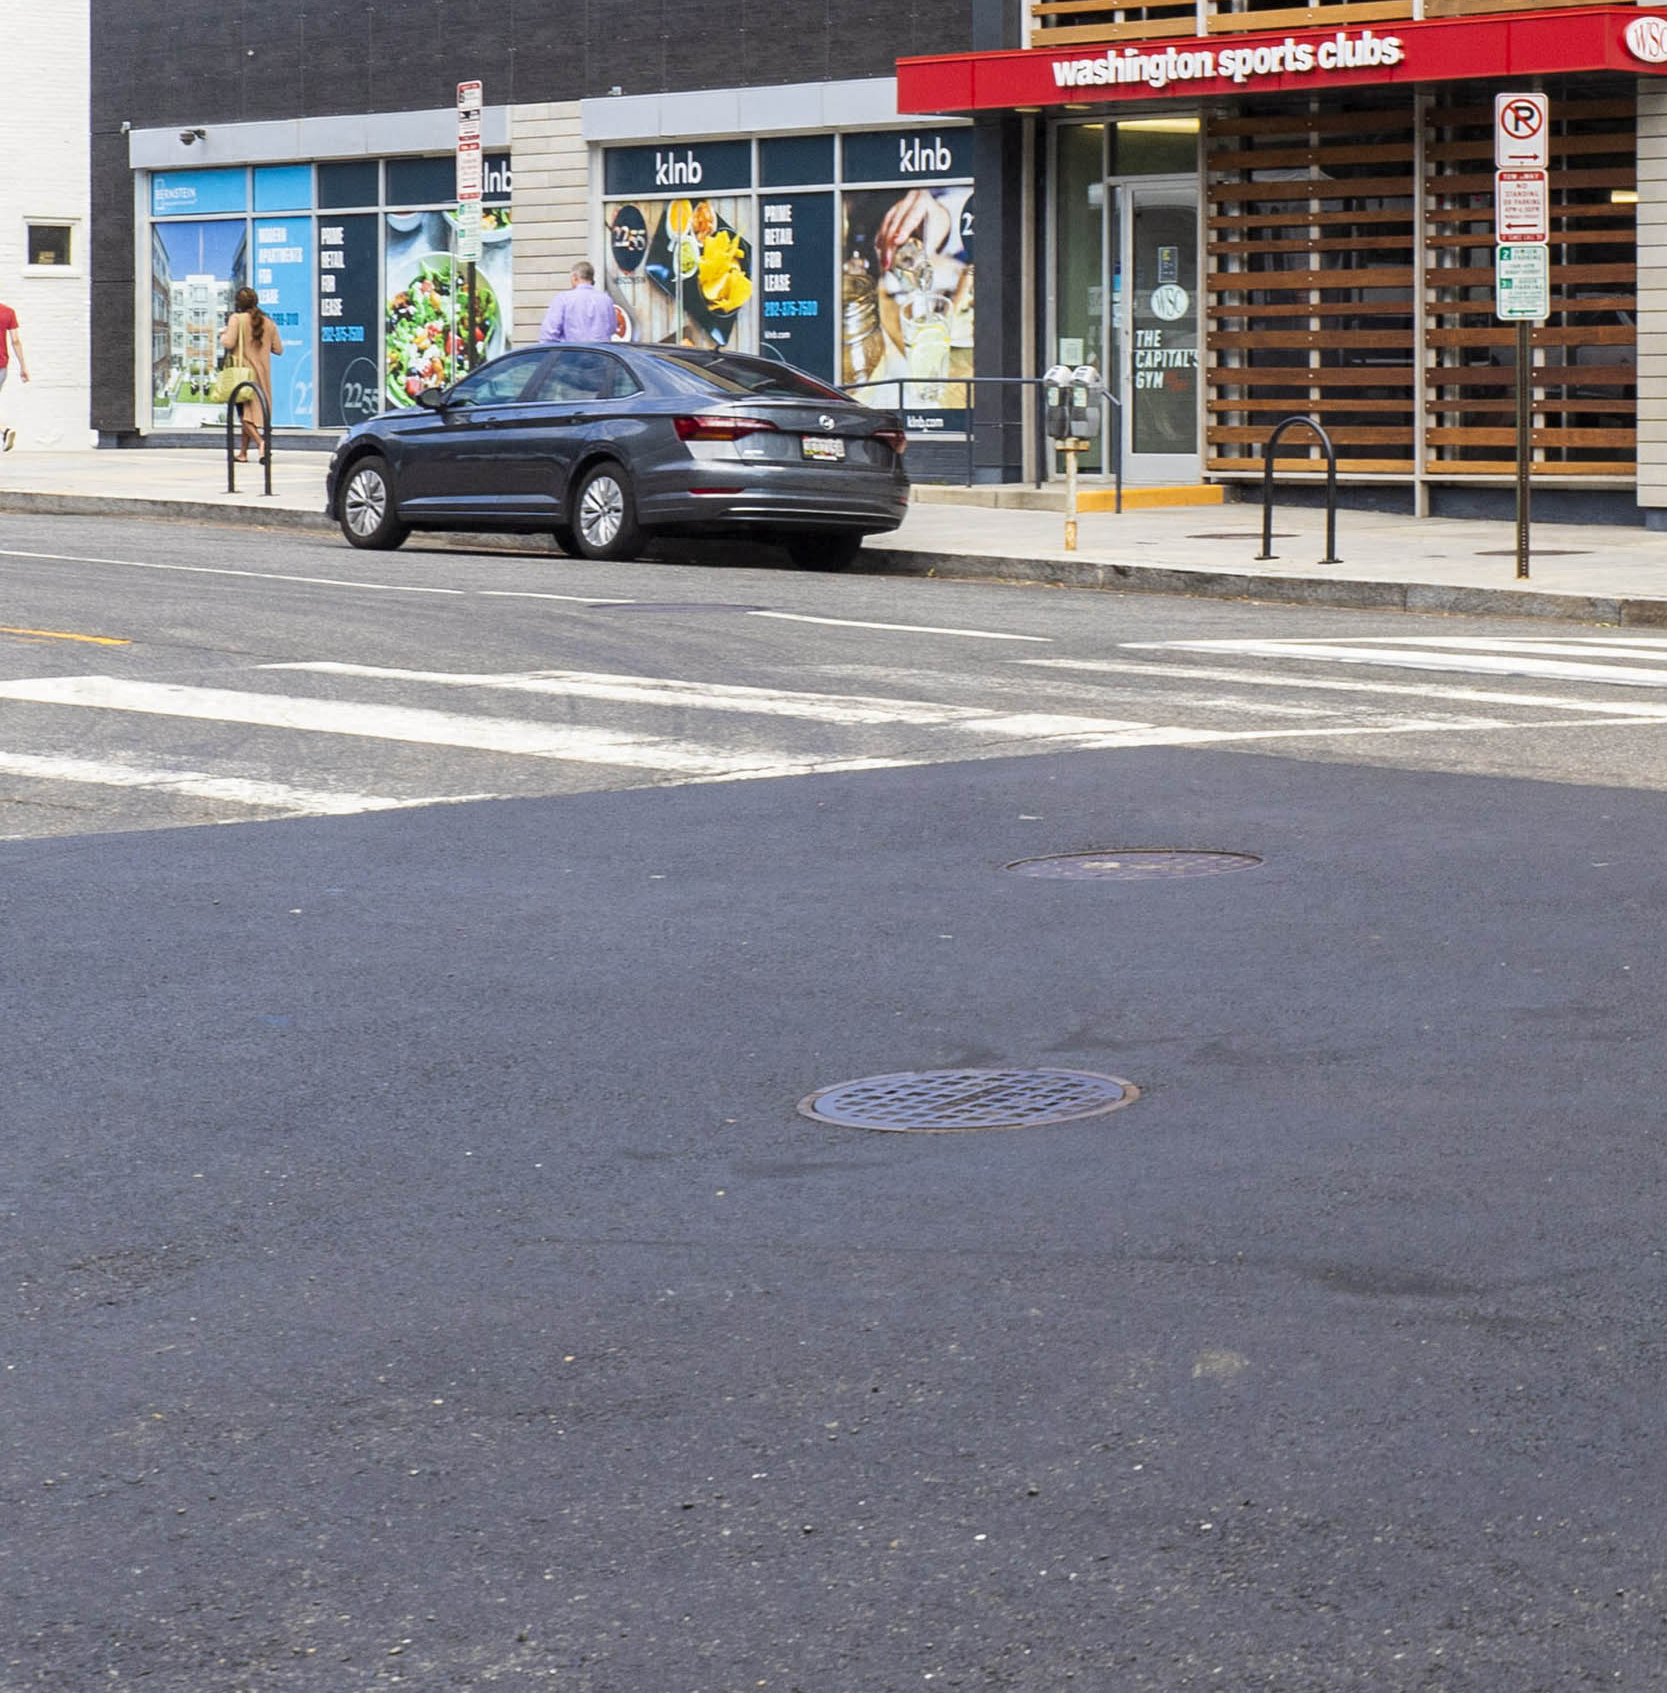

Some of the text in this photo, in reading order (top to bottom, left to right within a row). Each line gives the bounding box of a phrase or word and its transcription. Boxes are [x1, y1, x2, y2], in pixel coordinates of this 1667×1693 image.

[1052, 31, 1404, 88] washington sports clubs
[900, 137, 951, 172] klnb
[480, 161, 512, 194] lnb
[656, 151, 703, 186] klnb
[764, 204, 792, 223] PRIME
[764, 228, 794, 245] RETAIL
[764, 251, 782, 268] FOR
[764, 274, 791, 292] LEASE
[1135, 330, 1162, 347] THE
[1135, 371, 1164, 389] GYM
